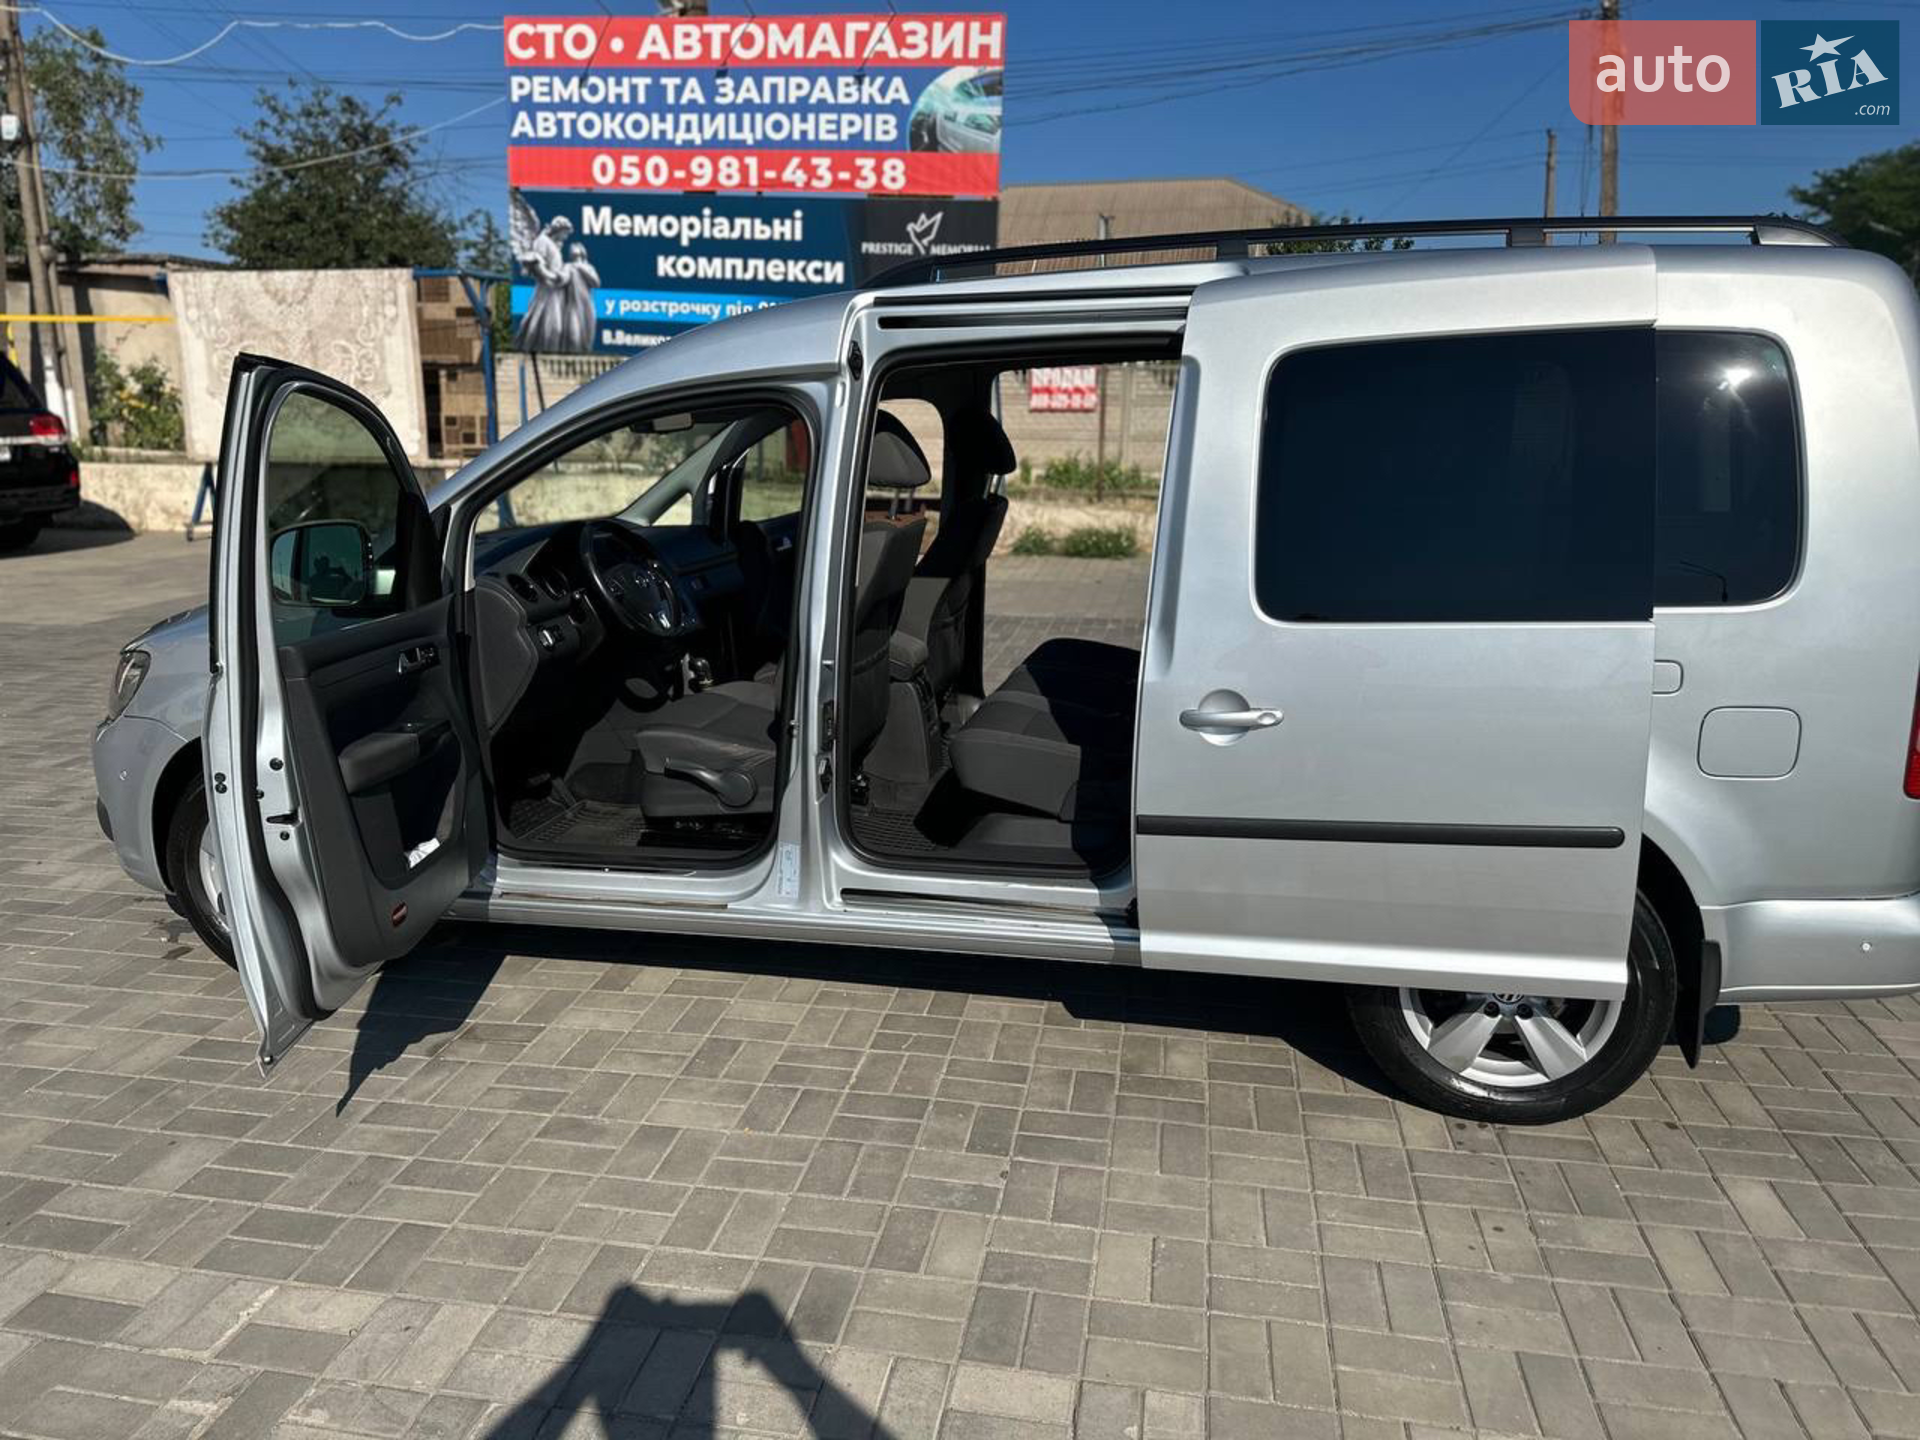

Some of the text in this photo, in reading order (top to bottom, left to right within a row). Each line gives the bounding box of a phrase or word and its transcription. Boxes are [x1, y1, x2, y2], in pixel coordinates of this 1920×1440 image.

[507, 20, 1003, 60] СТО АВТОМАГАЗИН
[510, 76, 911, 105] РЕМОНТ ТА ЗАПРАВКА
[510, 112, 898, 145] АВТОКОНДИЦІОНЕРІВ
[592, 154, 907, 189] 050-981-43-38
[582, 205, 803, 245] Меморіальні
[861, 241, 914, 255] PRESTIGE
[657, 252, 845, 285] комплекси
[605, 298, 616, 314] у
[619, 299, 721, 320] розстрочку
